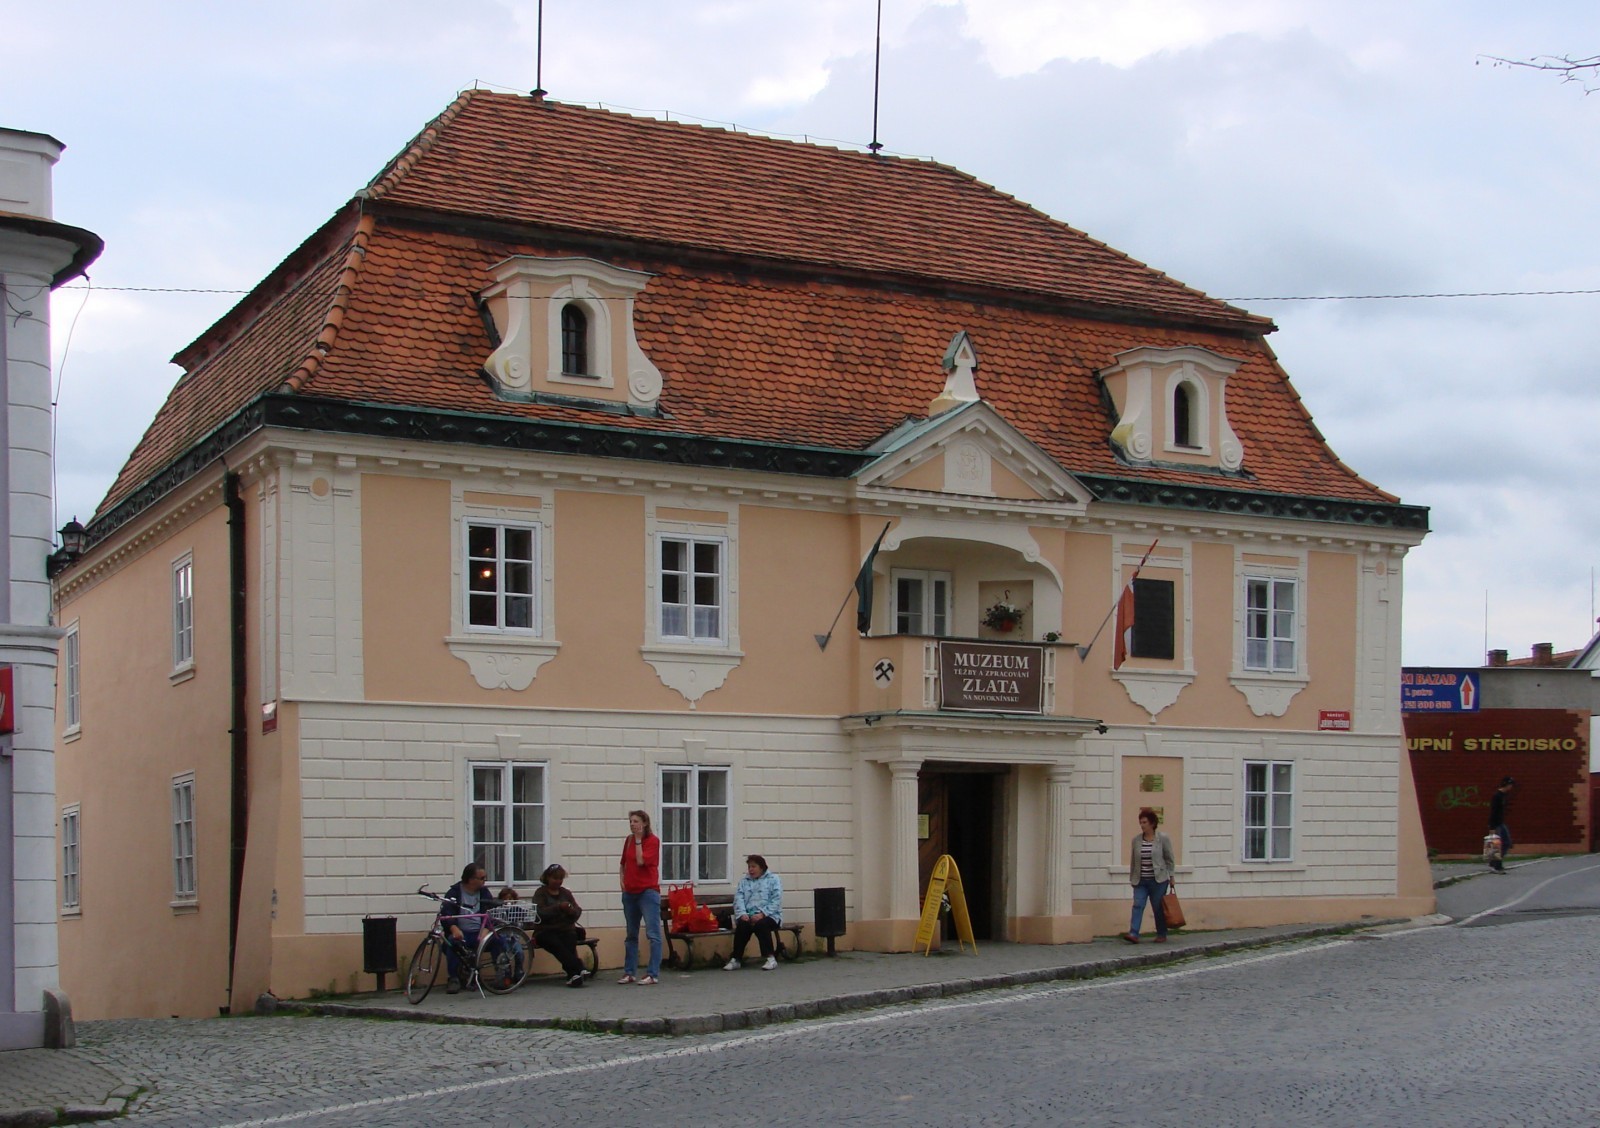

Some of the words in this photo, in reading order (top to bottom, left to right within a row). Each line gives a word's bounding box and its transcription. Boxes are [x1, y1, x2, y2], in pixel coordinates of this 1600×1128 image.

[954, 652, 1029, 670] MUZEUM
[985, 670, 1029, 678] ZPRACOVÁNÍ
[1415, 673, 1457, 686] BAZAR
[962, 678, 1020, 694] ZLATA
[1411, 688, 1434, 698] patro
[1463, 734, 1577, 752] STŘEDISKO
